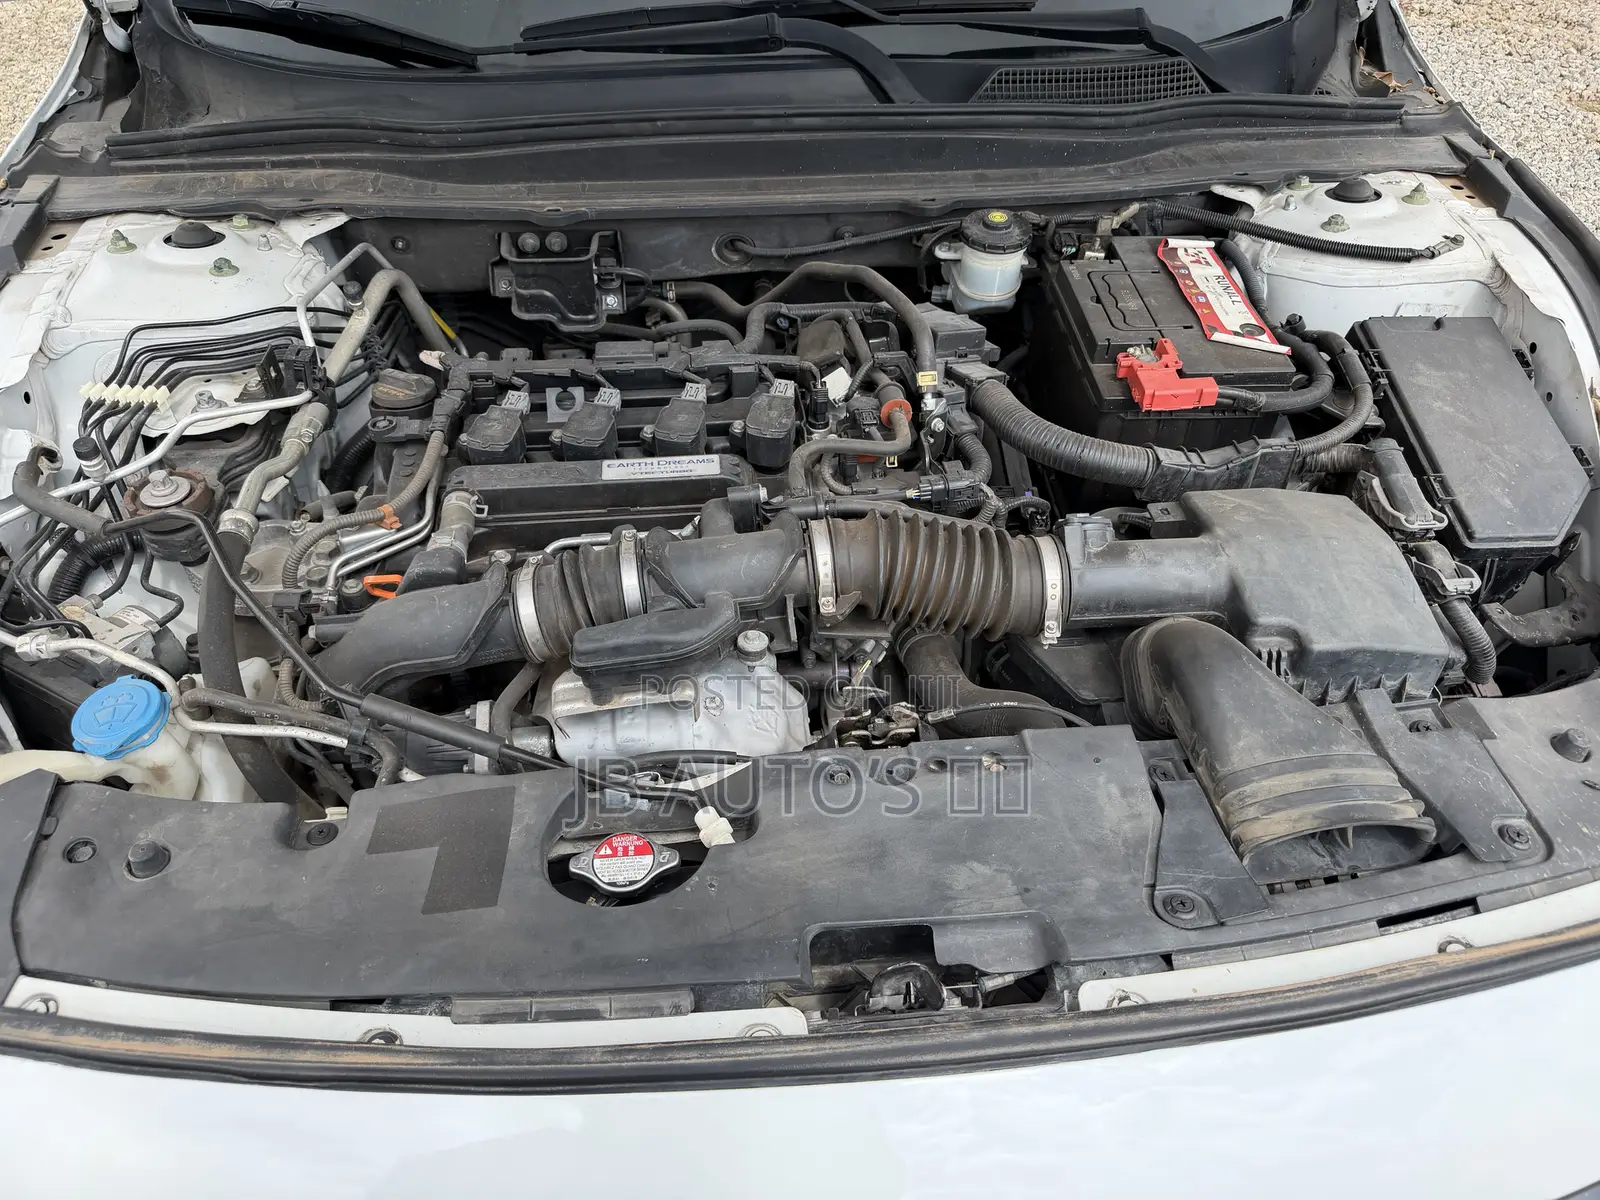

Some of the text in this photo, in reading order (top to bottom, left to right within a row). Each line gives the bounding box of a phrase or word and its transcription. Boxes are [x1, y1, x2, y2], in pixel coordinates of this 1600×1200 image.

[1213, 275, 1242, 305] RUNALL
[657, 458, 715, 466] DREAMS
[612, 840, 644, 848] WARNUNG
